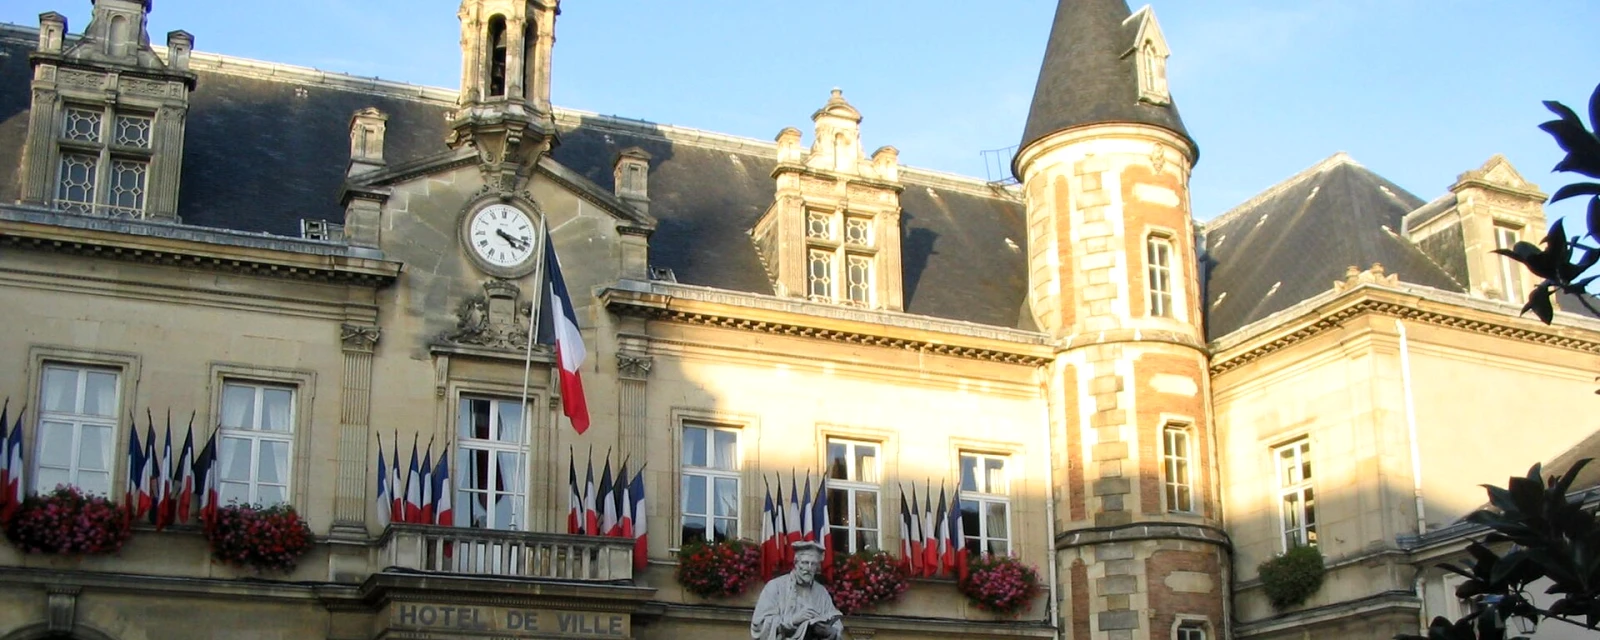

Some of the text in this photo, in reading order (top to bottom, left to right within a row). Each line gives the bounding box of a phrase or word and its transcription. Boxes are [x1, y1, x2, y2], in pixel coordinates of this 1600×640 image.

[400, 605, 623, 635] HOTEL DE VILLE
